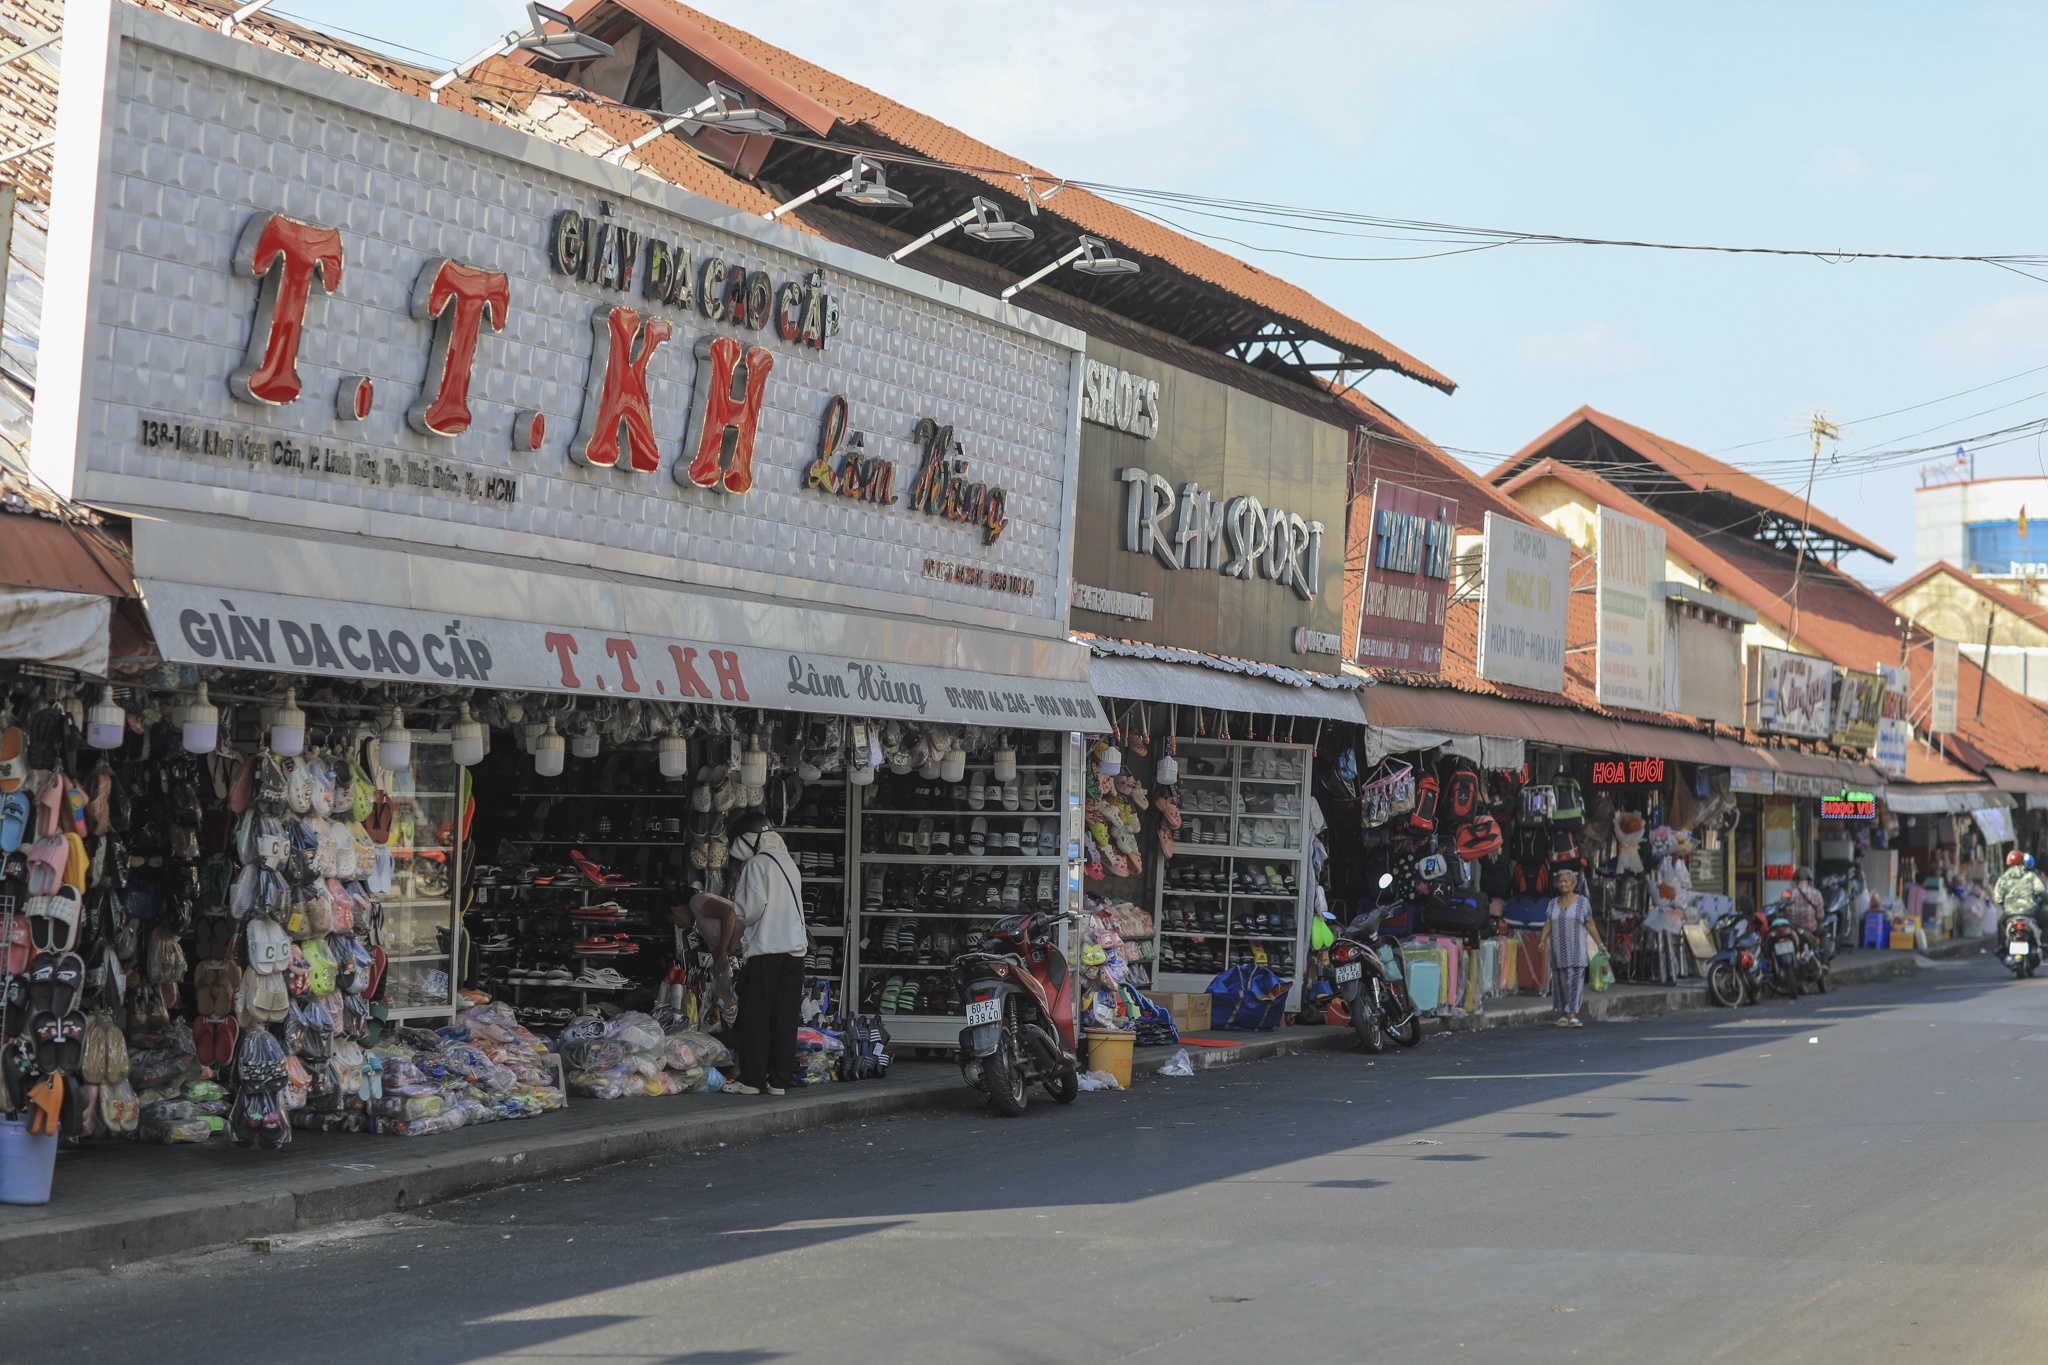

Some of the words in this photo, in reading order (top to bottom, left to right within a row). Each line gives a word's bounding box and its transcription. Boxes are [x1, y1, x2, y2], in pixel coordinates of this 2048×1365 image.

[552, 200, 642, 293] GIÀY
[643, 238, 693, 310] DA
[697, 257, 773, 332] CAO
[1082, 358, 1160, 440] SHOES
[803, 393, 899, 506] Lâm
[486, 476, 517, 504] HCM
[1514, 529, 1531, 558] SHOP
[1532, 536, 1547, 562] HOA
[1603, 516, 1624, 581] HOA
[1506, 567, 1535, 615] NGỌC
[179, 598, 276, 664] GIÀY
[278, 619, 344, 670] DA
[338, 625, 420, 675] CAO
[422, 619, 493, 682] CẤP
[1491, 623, 1507, 654] HOA
[1530, 633, 1545, 663] HOA
[787, 655, 850, 699] Lâm
[847, 661, 928, 716] Hằng
[988, 691, 1004, 712] 46
[1002, 692, 1031, 714] 2345
[1033, 694, 1062, 716] 0938
[1058, 697, 1079, 718] 100
[1075, 698, 1097, 719] 200
[1592, 761, 1625, 784] HOA
[1629, 756, 1664, 783] TƯƠI
[969, 1010, 999, 1025] 838.40
[971, 1000, 995, 1014] 60-F2
